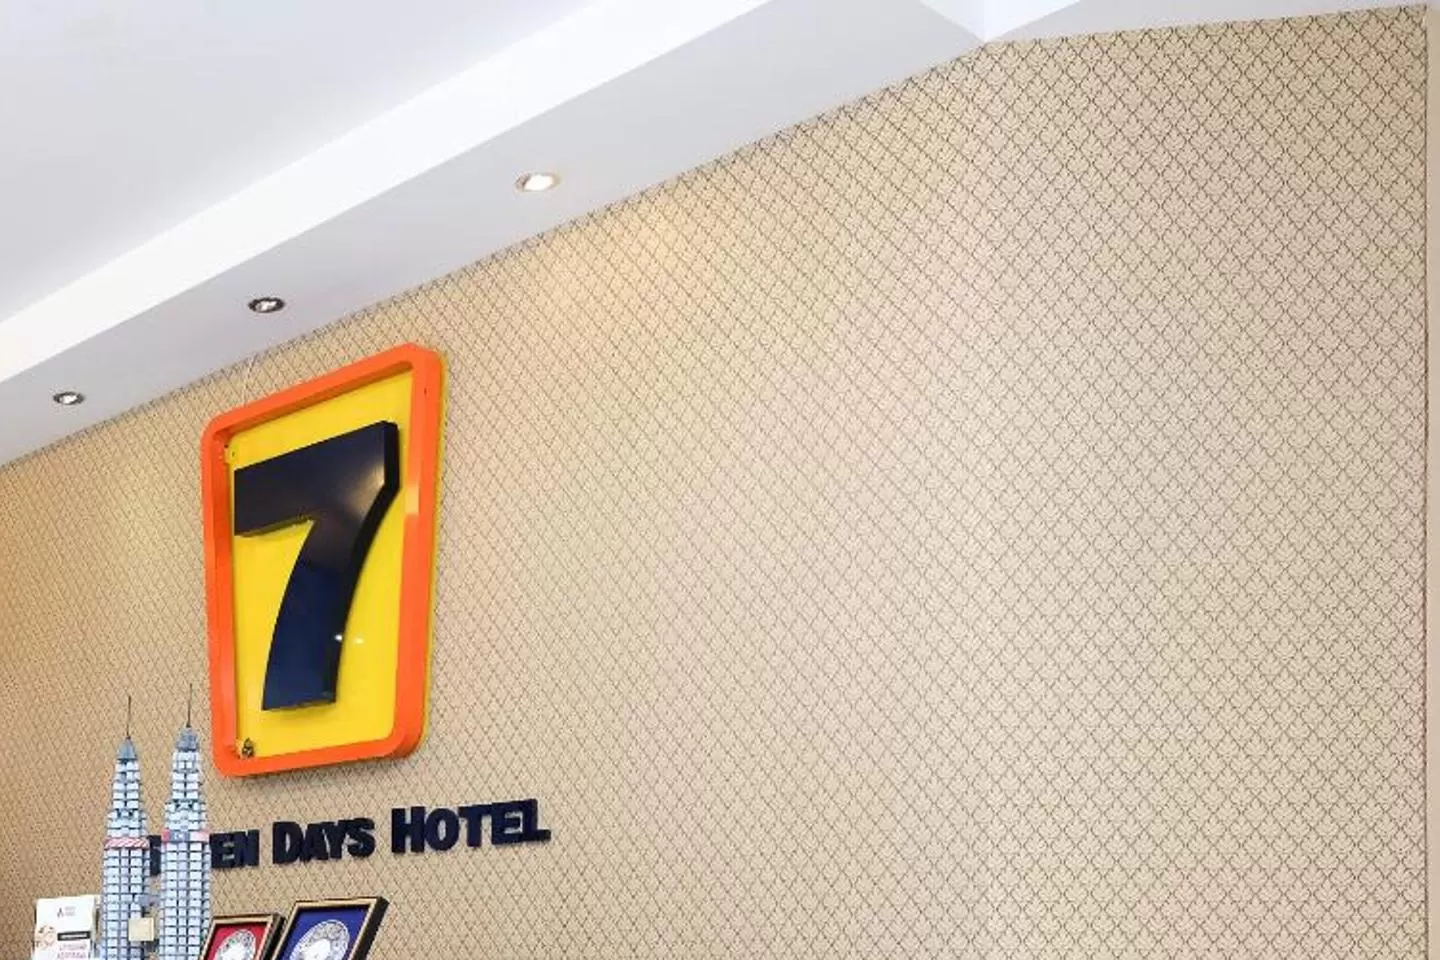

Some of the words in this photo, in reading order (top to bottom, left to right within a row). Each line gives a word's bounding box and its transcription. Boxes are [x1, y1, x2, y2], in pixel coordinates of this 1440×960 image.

[234, 420, 400, 711] 7
[272, 817, 376, 865] DAYS
[390, 798, 552, 854] HOTEL
